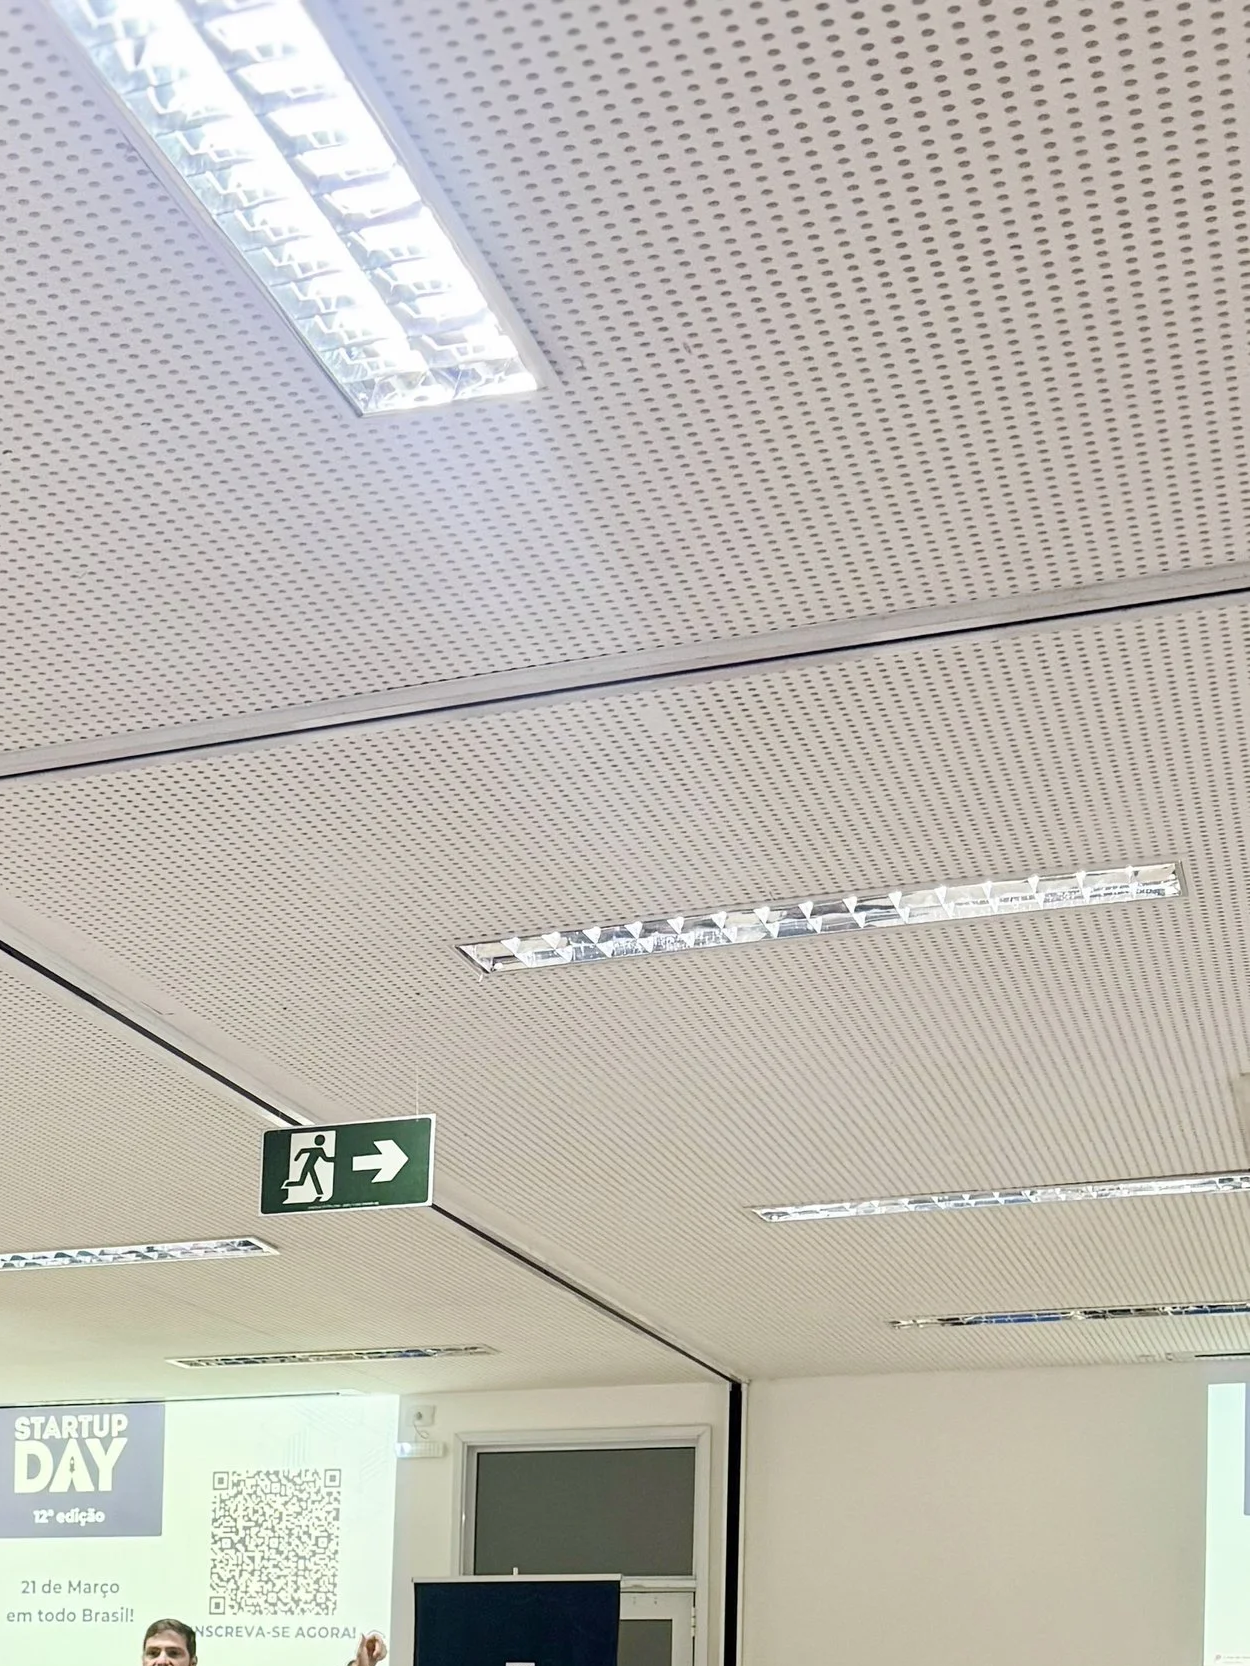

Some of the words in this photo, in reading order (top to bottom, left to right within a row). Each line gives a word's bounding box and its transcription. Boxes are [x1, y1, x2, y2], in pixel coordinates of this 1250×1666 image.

[14, 1413, 128, 1440] STARTUP
[14, 1437, 128, 1494] DAY
[55, 1507, 106, 1527] edição
[21, 1580, 36, 1594] 21
[41, 1579, 62, 1594] de
[67, 1580, 120, 1598] Março
[6, 1611, 32, 1622] em
[37, 1607, 77, 1622] todo
[82, 1606, 134, 1622] Brasil!
[192, 1625, 291, 1639] NSCREVA-SE
[294, 1626, 356, 1639] AGORA!
